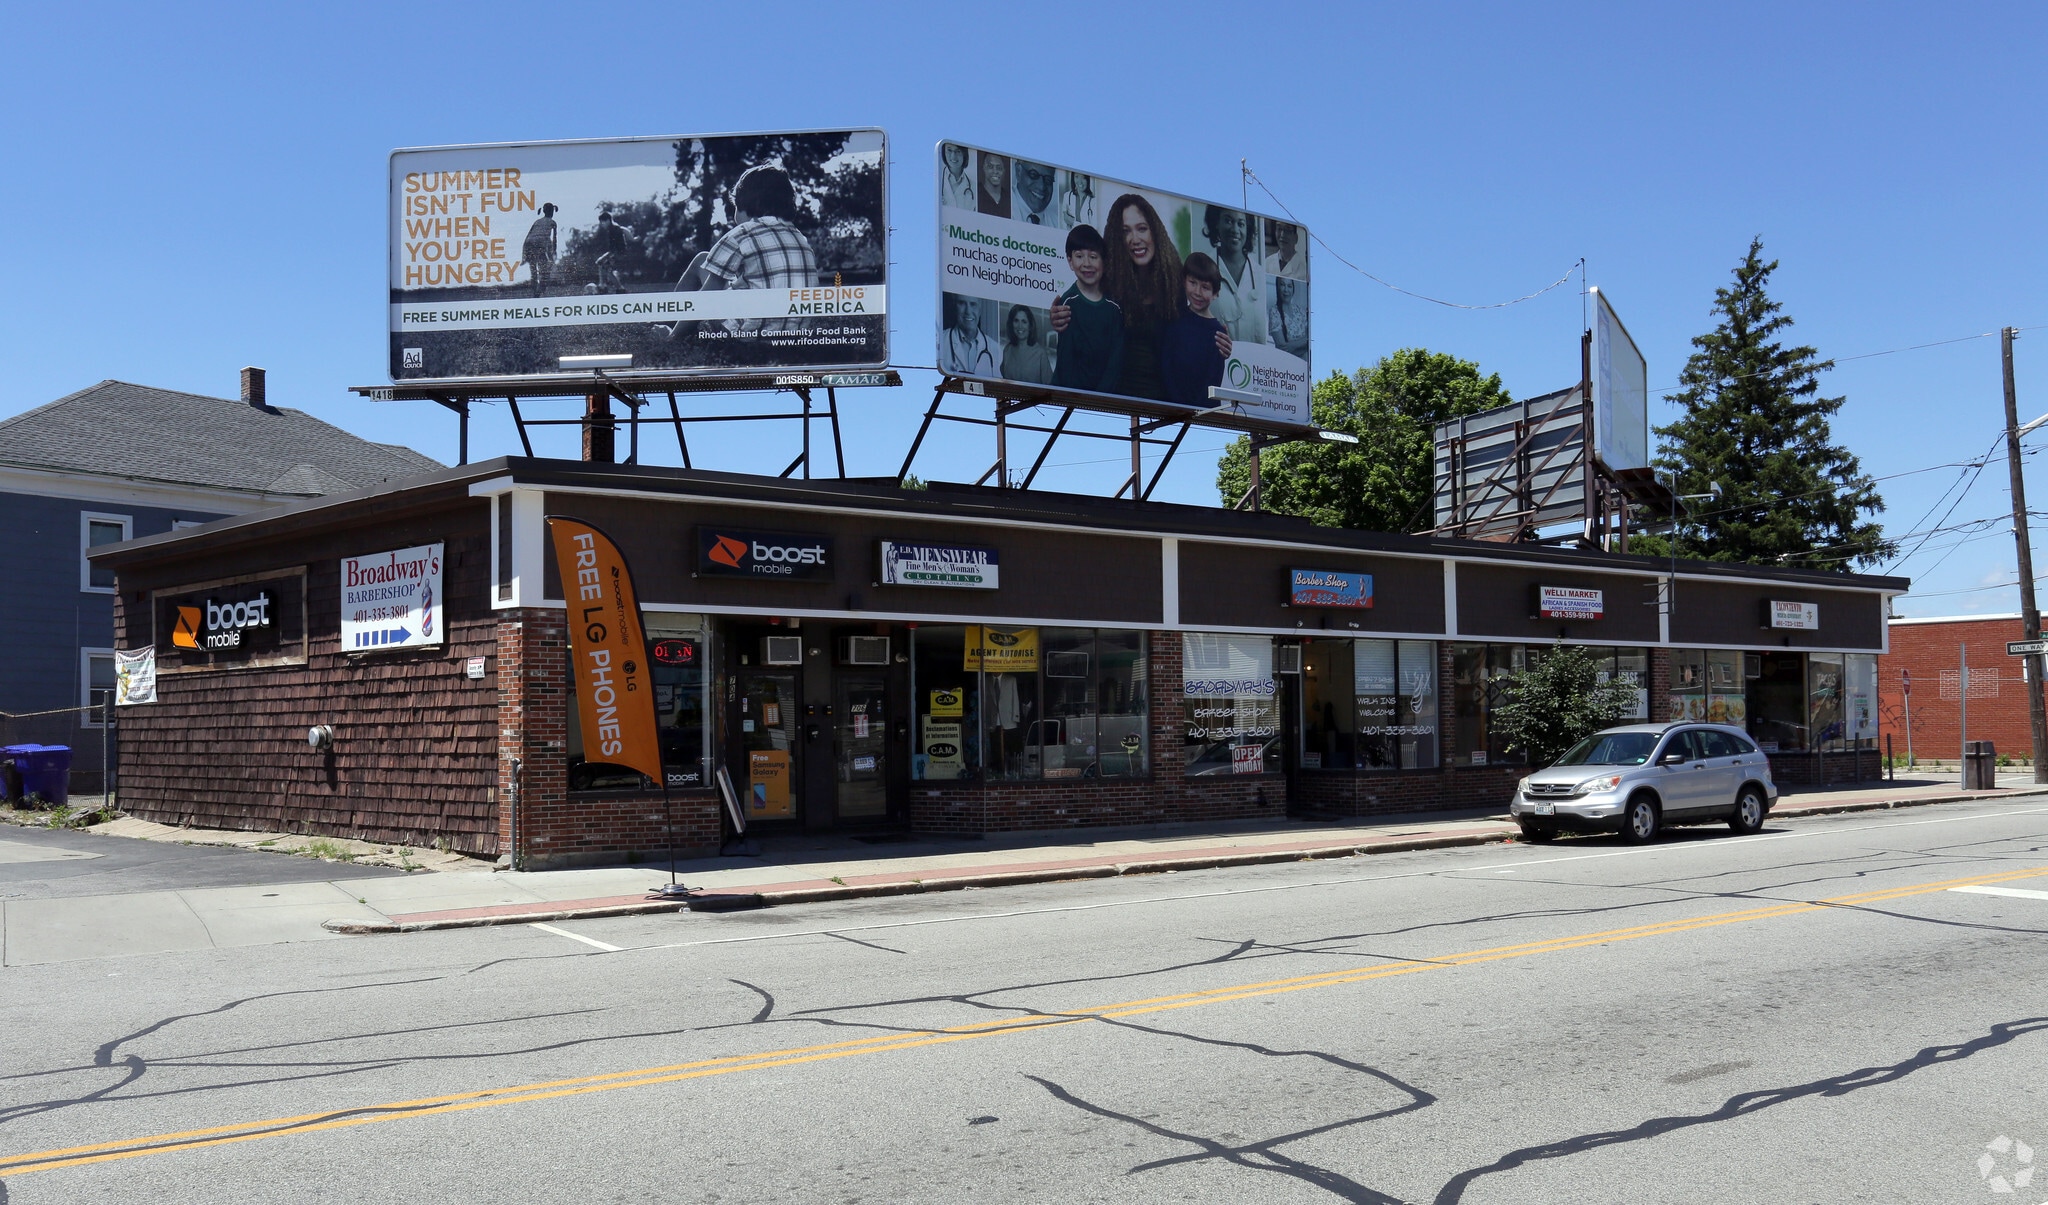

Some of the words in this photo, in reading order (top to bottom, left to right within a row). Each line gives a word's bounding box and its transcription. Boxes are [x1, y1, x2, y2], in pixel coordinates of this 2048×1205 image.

[405, 168, 522, 193] SUMMER
[406, 193, 473, 216] ISN'T
[481, 190, 536, 213] FUN
[405, 216, 491, 240] WHEN
[405, 238, 506, 262] YOU'RE
[1002, 236, 1065, 260] doctores...
[953, 246, 998, 264] muchas
[1001, 255, 1052, 274] opciones
[405, 260, 521, 286] HUNGRY
[947, 263, 969, 277] con
[789, 288, 865, 302] FEEDING
[403, 312, 438, 323] FREE
[441, 310, 499, 322] SUMMER
[504, 307, 550, 320] MEALS
[555, 306, 583, 317] FOR
[587, 304, 619, 316] KIDS
[623, 303, 653, 314] CAN
[657, 301, 695, 312] HELP.
[788, 301, 866, 315] AMERICA
[698, 331, 728, 340] Rhode
[731, 328, 758, 338] Island
[761, 326, 813, 339] Community
[816, 326, 840, 336] Food
[843, 325, 866, 335] Bank
[771, 336, 867, 346] www.rifoodbank.org
[405, 352, 420, 364] Ad
[828, 375, 880, 385] LAMAR
[1252, 365, 1305, 383] Neighborhood
[969, 383, 974, 392] 4
[1252, 376, 1279, 389] Health
[1281, 380, 1297, 391] Plan
[753, 541, 826, 565] boost
[913, 547, 988, 565] MENSWEAR
[346, 547, 439, 588] Broadway's
[572, 532, 602, 600] FREE
[753, 564, 792, 574] mobile
[906, 561, 921, 571] Fine
[923, 562, 942, 571] Men's
[950, 563, 980, 573] Woman's
[906, 573, 981, 583] CLOTHING
[1295, 572, 1324, 586] Barber
[1325, 574, 1349, 591] Shop
[347, 583, 416, 604] BARBERSHOP
[1569, 591, 1598, 599] MARKET
[207, 592, 269, 631] boost
[354, 605, 409, 624] 401-335-3801
[1551, 611, 1594, 619] 401-359-9910
[583, 606, 607, 644] LG
[207, 631, 240, 648] mobile
[971, 648, 997, 657] AGENT
[2030, 643, 2046, 651] WAY
[626, 676, 637, 692] LG
[1185, 678, 1276, 696] BROADWAY'S
[589, 650, 622, 757] PHONES
[1380, 697, 1397, 705] INS
[1241, 708, 1269, 718] SHOP
[1188, 726, 1275, 739] 401-335-3801
[1362, 725, 1435, 736] 401-335-3801
[930, 746, 955, 755] C.A.M.
[1234, 747, 1261, 761] OPEN
[753, 762, 785, 770] Samsung
[753, 769, 778, 777] Galaxy
[1234, 760, 1261, 774] SUNDAY
[668, 772, 699, 782] boost
